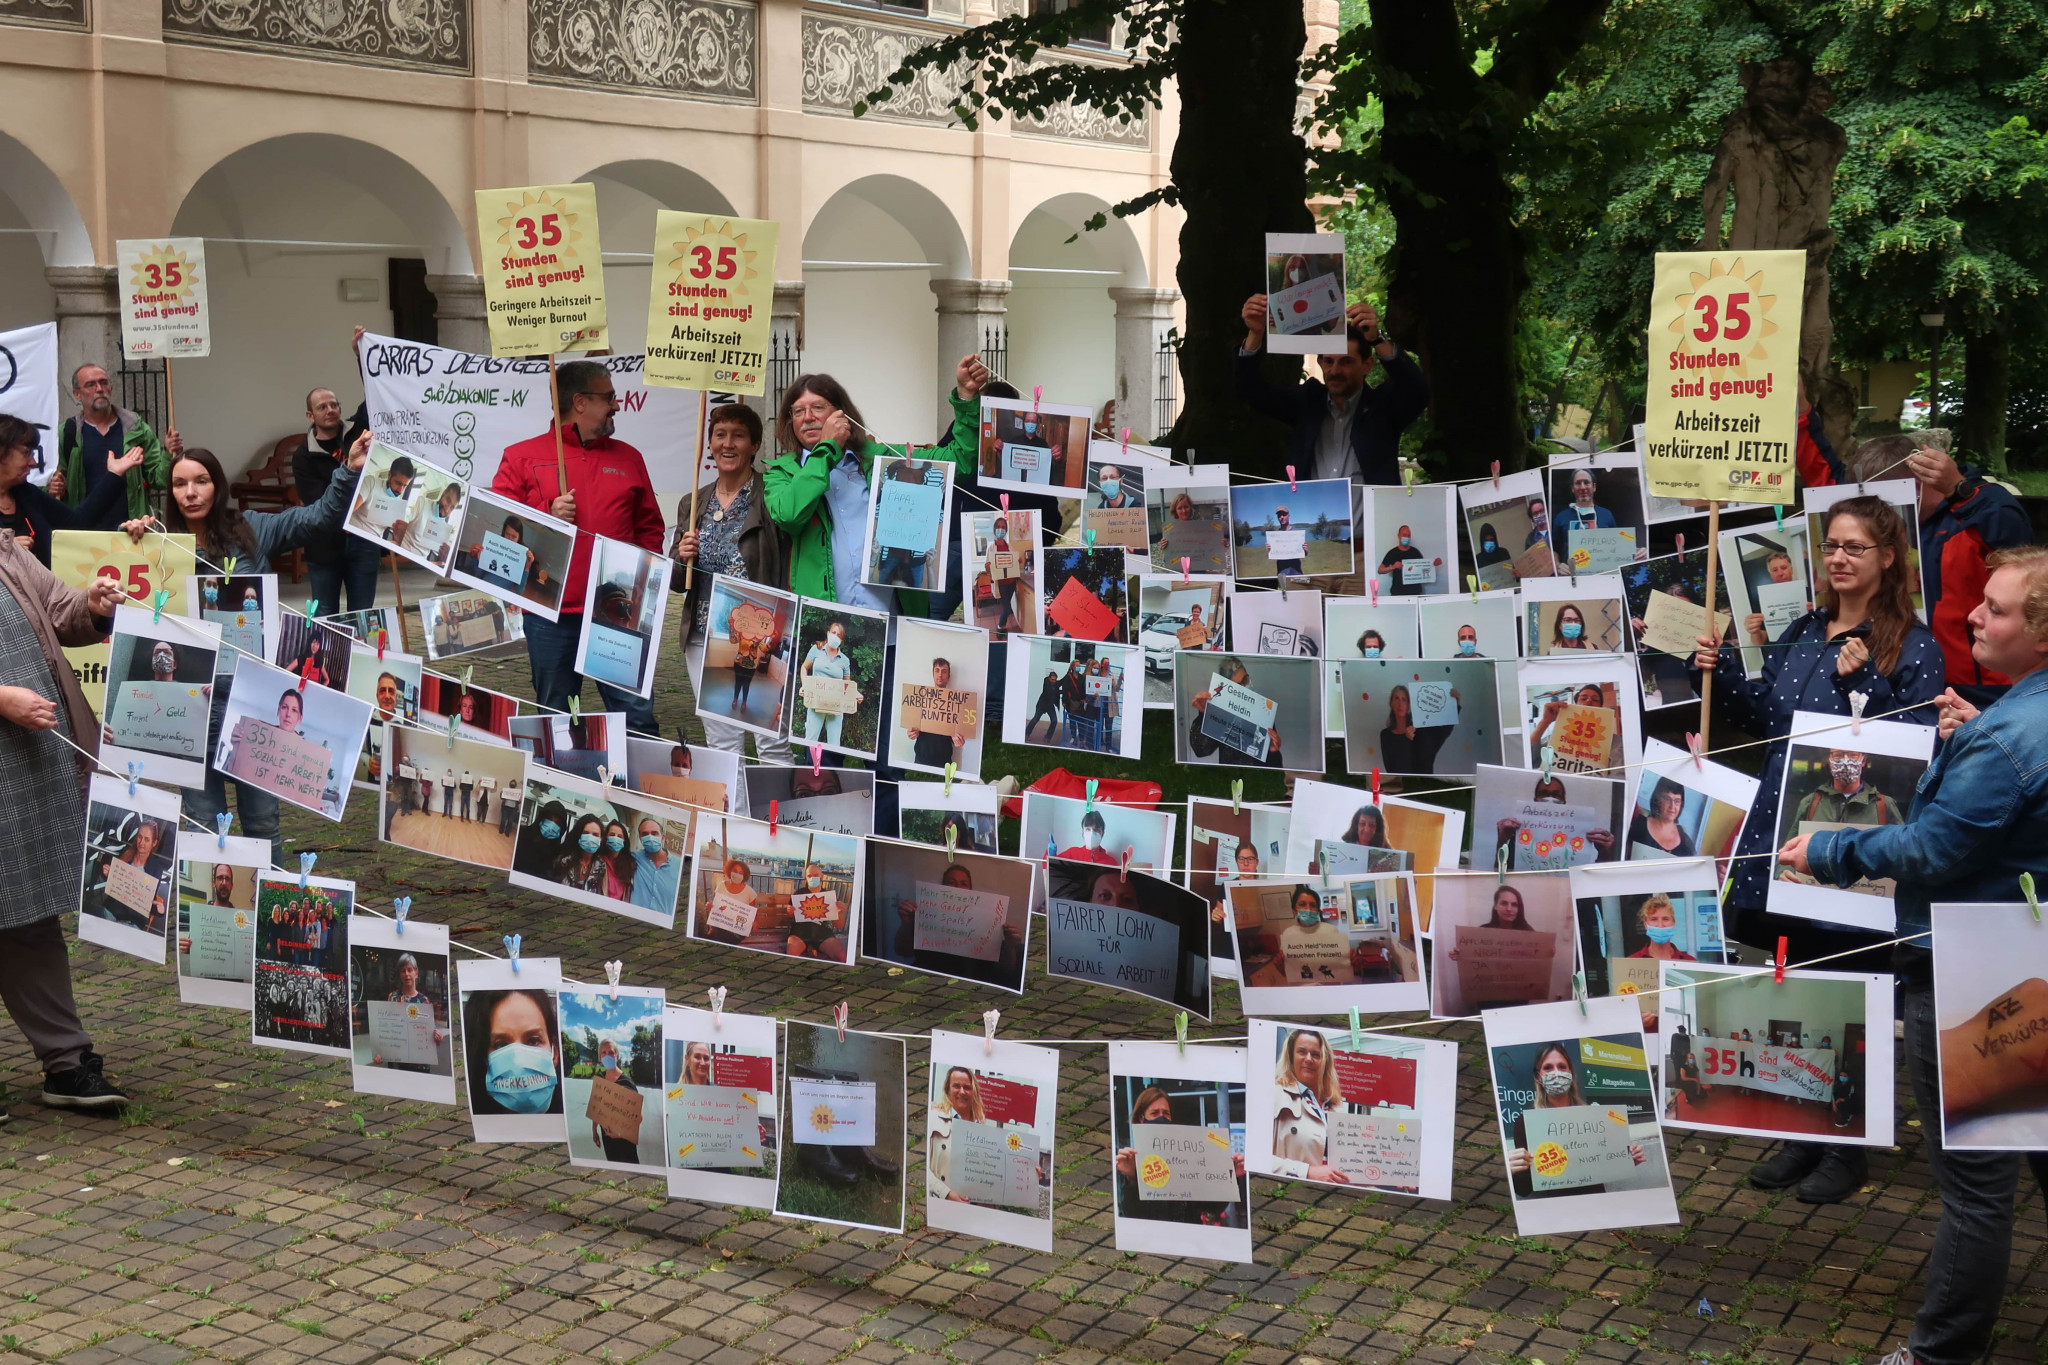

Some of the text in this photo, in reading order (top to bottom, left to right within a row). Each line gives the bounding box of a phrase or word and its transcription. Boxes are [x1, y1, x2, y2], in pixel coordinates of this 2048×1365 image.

[516, 214, 562, 249] 35
[501, 252, 557, 270] Stunden
[690, 246, 737, 279] 35
[145, 262, 182, 289] 35
[505, 265, 585, 288] sind genug!
[132, 292, 177, 305] Stunden
[668, 283, 727, 298] Stunden
[135, 303, 198, 318] sind genug!
[490, 294, 591, 312] Geringere Arbeitszeit
[507, 311, 587, 327] Weniger Burnout
[668, 302, 752, 322] sind genug!
[1693, 293, 1751, 342] 35
[133, 324, 198, 332] www.35stunden.at
[671, 325, 741, 346] Arbeitszeit
[132, 340, 152, 350] vida
[367, 344, 442, 377] CARITAS
[647, 345, 762, 367] verkürzen! JETZT!
[1670, 348, 1740, 370] Stunden
[714, 370, 740, 381] GPA
[1671, 373, 1772, 401] sind genug!
[1675, 410, 1760, 433] Arbeitszeit
[1650, 438, 1788, 463] verkürzen! JETZT!
[1729, 470, 1760, 485] GPA
[913, 686, 970, 704] LÖHNE RAUF
[1228, 685, 1256, 704] Gestern
[902, 695, 962, 713] ARBEITSZEIT
[1228, 700, 1251, 717] Heldin
[921, 709, 958, 724] RUNTER
[963, 709, 976, 725] 35
[1572, 721, 1595, 738] 35
[1560, 736, 1589, 747] Stunden
[282, 745, 297, 757] sind
[1558, 746, 1601, 761] sind genug!
[249, 748, 322, 782] SOZIALE ARBEIT
[255, 767, 321, 797] IST MEHR WERT
[1057, 903, 1155, 941] FAIRER LOHN
[1097, 936, 1121, 953] FÜR
[1058, 957, 1105, 975] SOZIALE
[1117, 965, 1156, 983] ARBEIT
[1988, 997, 2024, 1029] AZ
[1759, 1051, 1778, 1065] sind
[1758, 1070, 1778, 1081] genug
[1784, 1051, 1834, 1087] HAUS MIRIAM
[817, 1114, 828, 1124] 35
[1548, 1121, 1606, 1136] APPLAUS
[1153, 1137, 1205, 1153] APPLAUS
[1598, 1137, 1607, 1147] ist
[1539, 1148, 1558, 1163] 35
[1579, 1155, 1601, 1164] NICHT
[1145, 1162, 1162, 1174] 35
[1537, 1157, 1567, 1173] STUNDEN
[1144, 1169, 1169, 1182] STUNDEN
